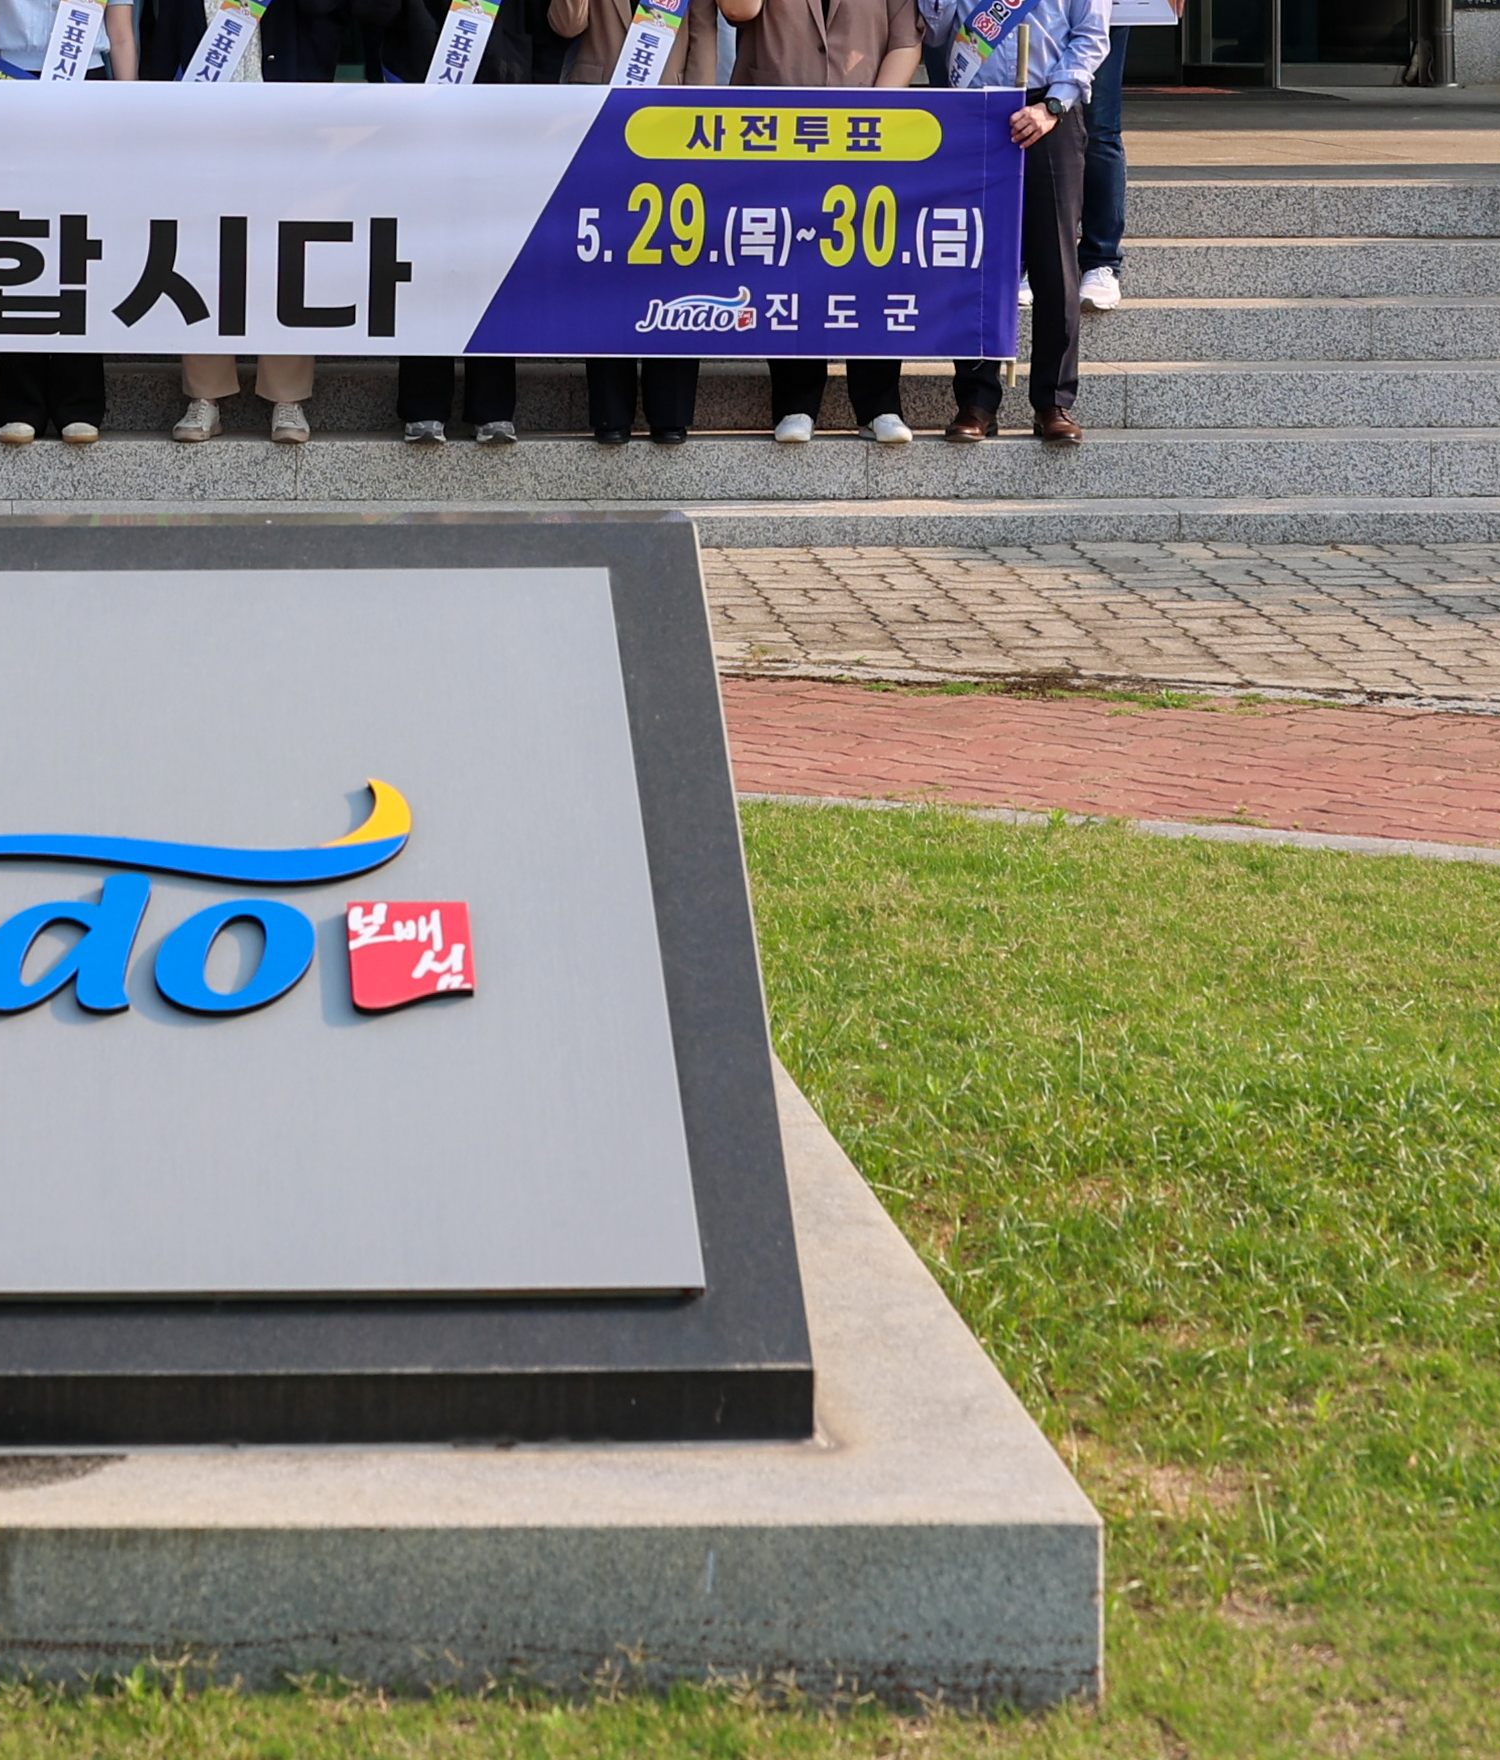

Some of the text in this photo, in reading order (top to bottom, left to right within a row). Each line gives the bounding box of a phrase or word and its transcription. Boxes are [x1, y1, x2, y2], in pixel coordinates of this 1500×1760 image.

[626, 31, 661, 86] 투표합
[685, 114, 884, 154] 사전투표
[636, 296, 737, 334] Jindo
